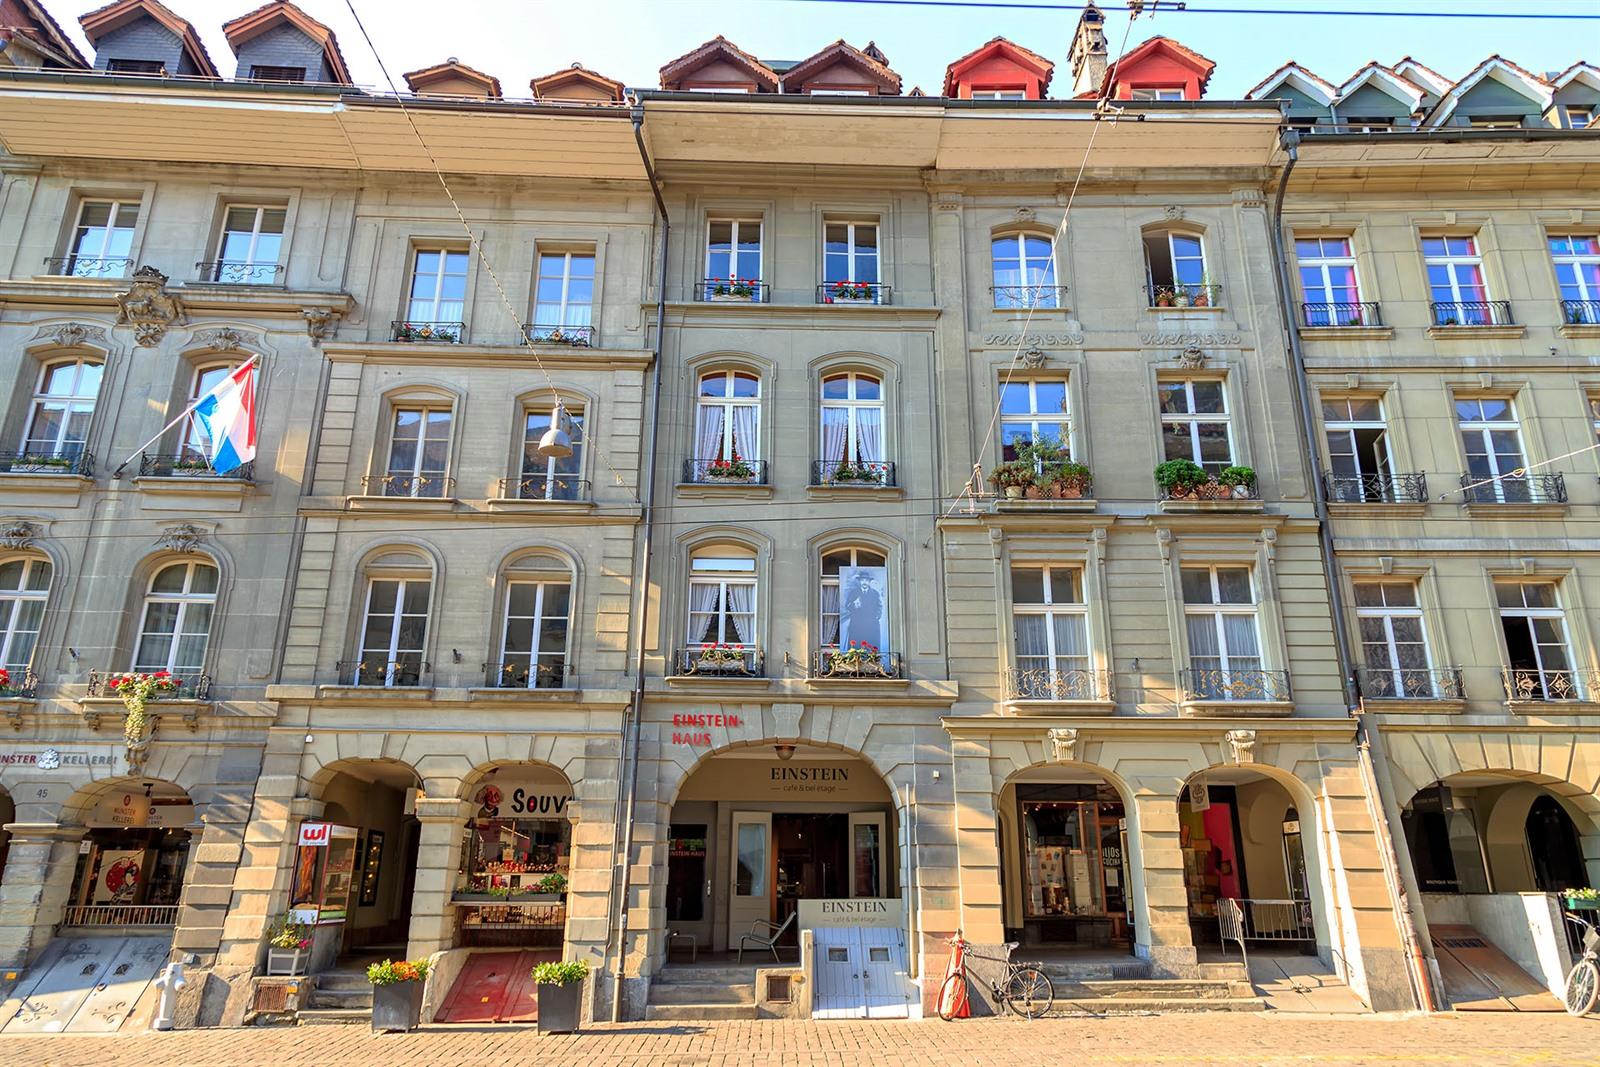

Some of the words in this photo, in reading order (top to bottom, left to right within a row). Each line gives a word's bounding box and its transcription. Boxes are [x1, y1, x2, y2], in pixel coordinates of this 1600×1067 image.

[672, 714, 744, 728] EINSTEIN-
[672, 732, 712, 746] HAUS
[62, 756, 117, 765] KELLEREI
[771, 767, 849, 781] EINSTEIN
[37, 788, 48, 798] 45
[799, 784, 804, 792] &
[822, 901, 887, 913] EINSTEIN
